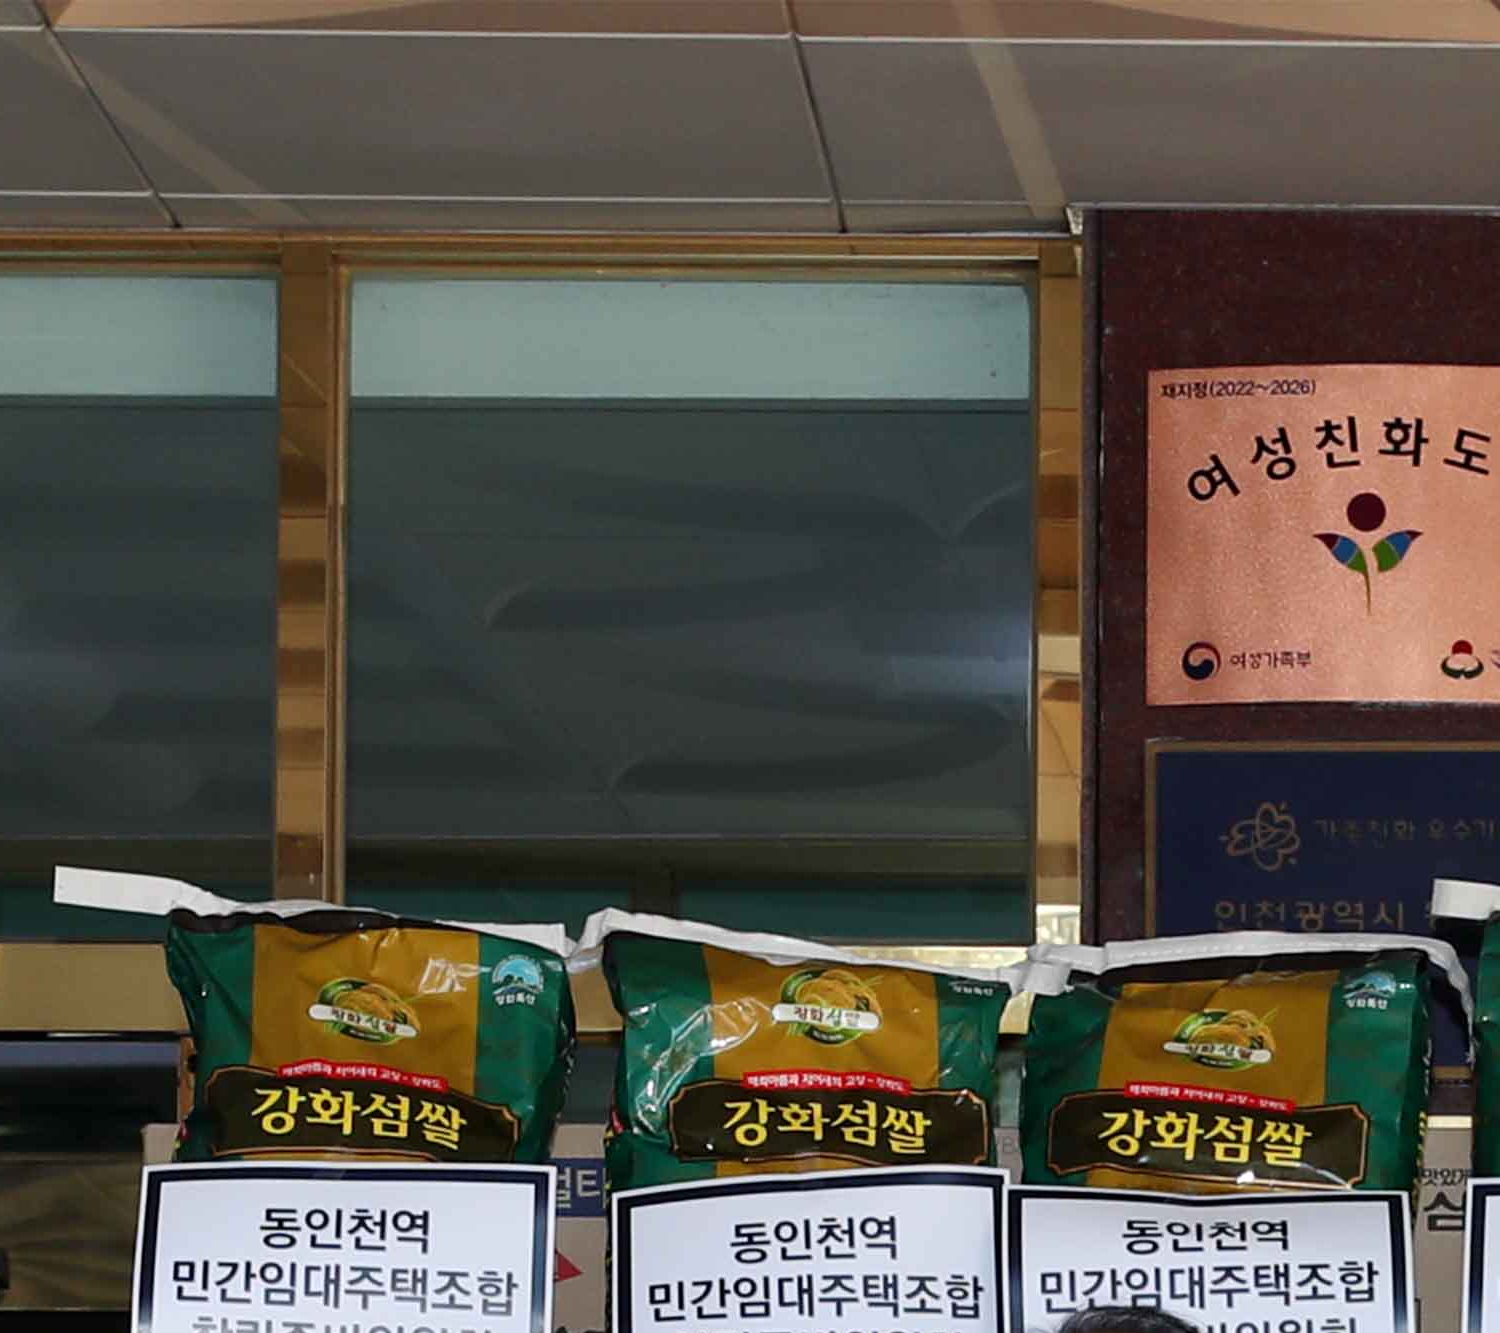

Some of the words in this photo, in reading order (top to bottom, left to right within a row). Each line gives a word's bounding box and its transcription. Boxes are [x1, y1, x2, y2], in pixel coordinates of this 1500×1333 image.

[1230, 650, 1312, 670] 여성가족부
[251, 1085, 467, 1151] 강화섬쌀
[723, 1098, 931, 1154] 강화섬쌀
[1098, 1108, 1312, 1166] 강화섬쌀
[259, 1208, 431, 1251] 동인천역
[730, 1214, 898, 1262] 동인천역
[1122, 1218, 1290, 1254] 동인천역
[172, 1260, 518, 1317] 민간임대주택조합
[648, 1273, 984, 1323] 민간임대주택조합
[1039, 1260, 1380, 1312] 민간임대주택조합
